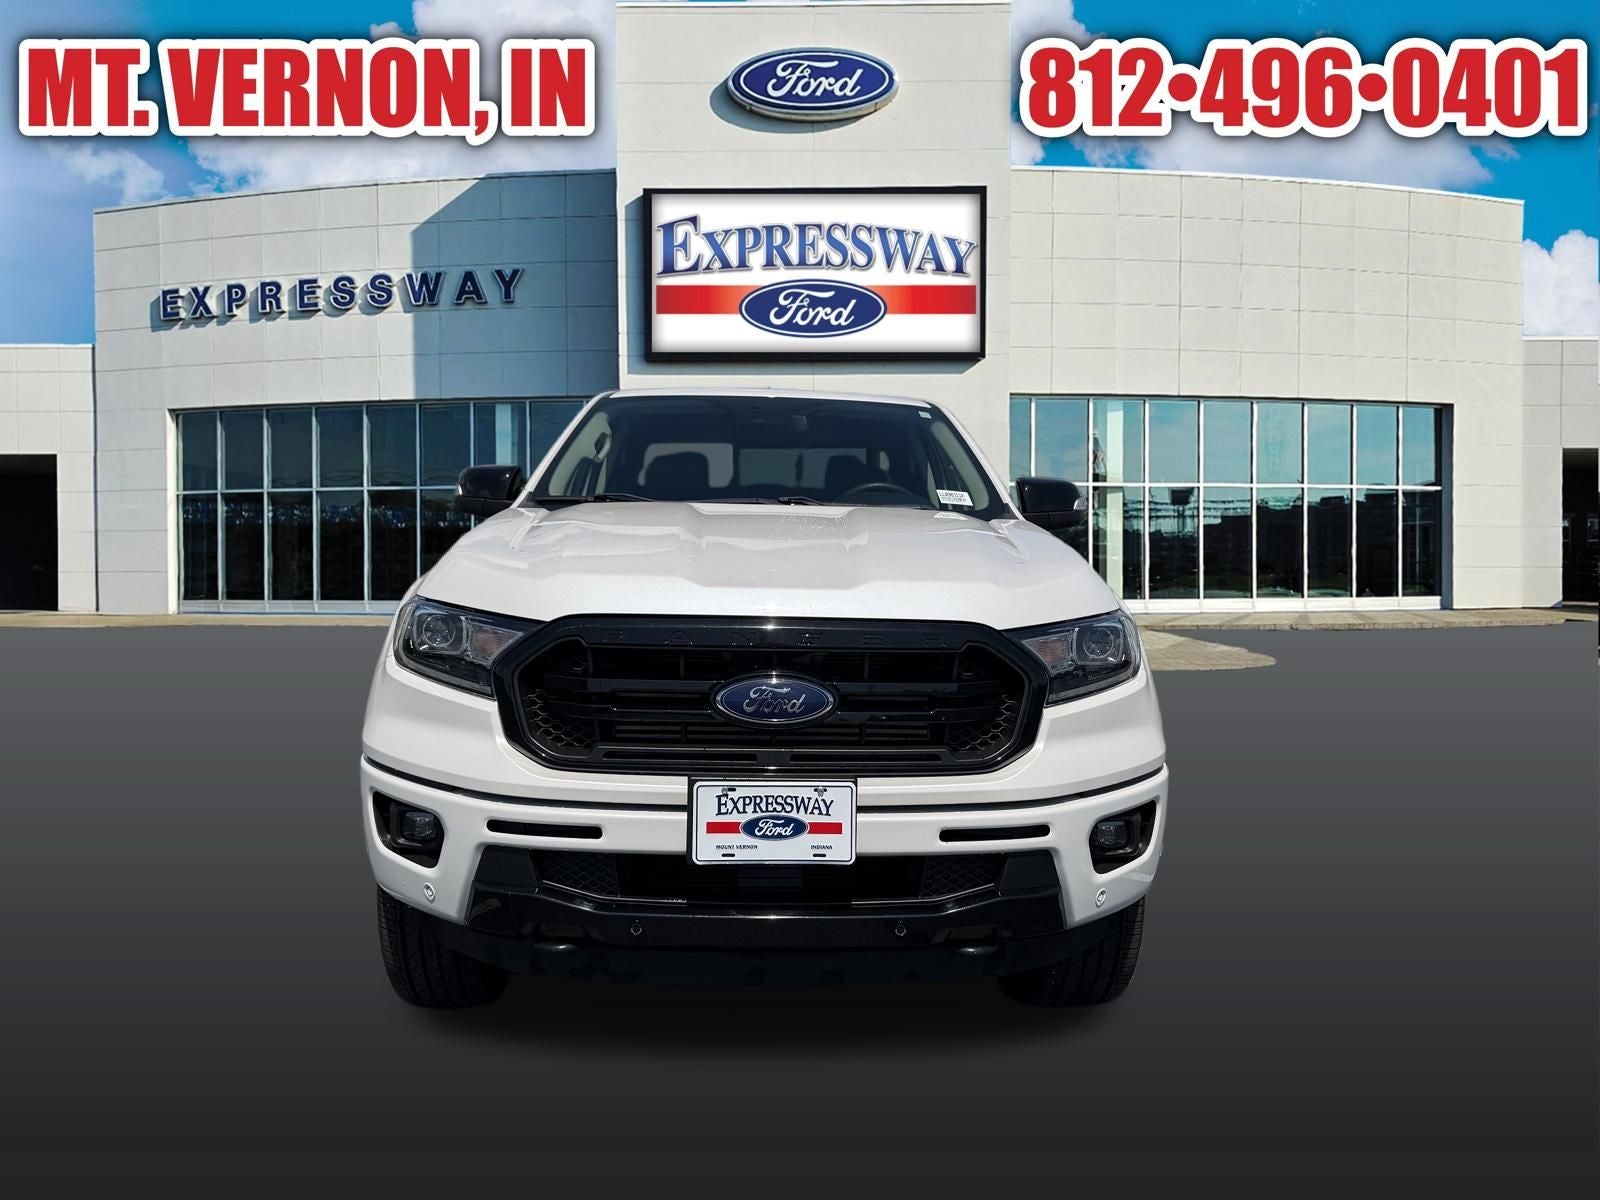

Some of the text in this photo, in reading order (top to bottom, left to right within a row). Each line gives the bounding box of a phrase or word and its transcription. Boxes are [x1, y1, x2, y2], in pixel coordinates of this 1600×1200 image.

[766, 59, 863, 97] Ford
[655, 214, 977, 278] EXPRESSWAY
[159, 267, 526, 322] EXPRESSWAY
[769, 288, 857, 326] Ford
[742, 686, 807, 714] Ford
[715, 793, 834, 816] EXPRESSWAY
[754, 818, 794, 836] Ford
